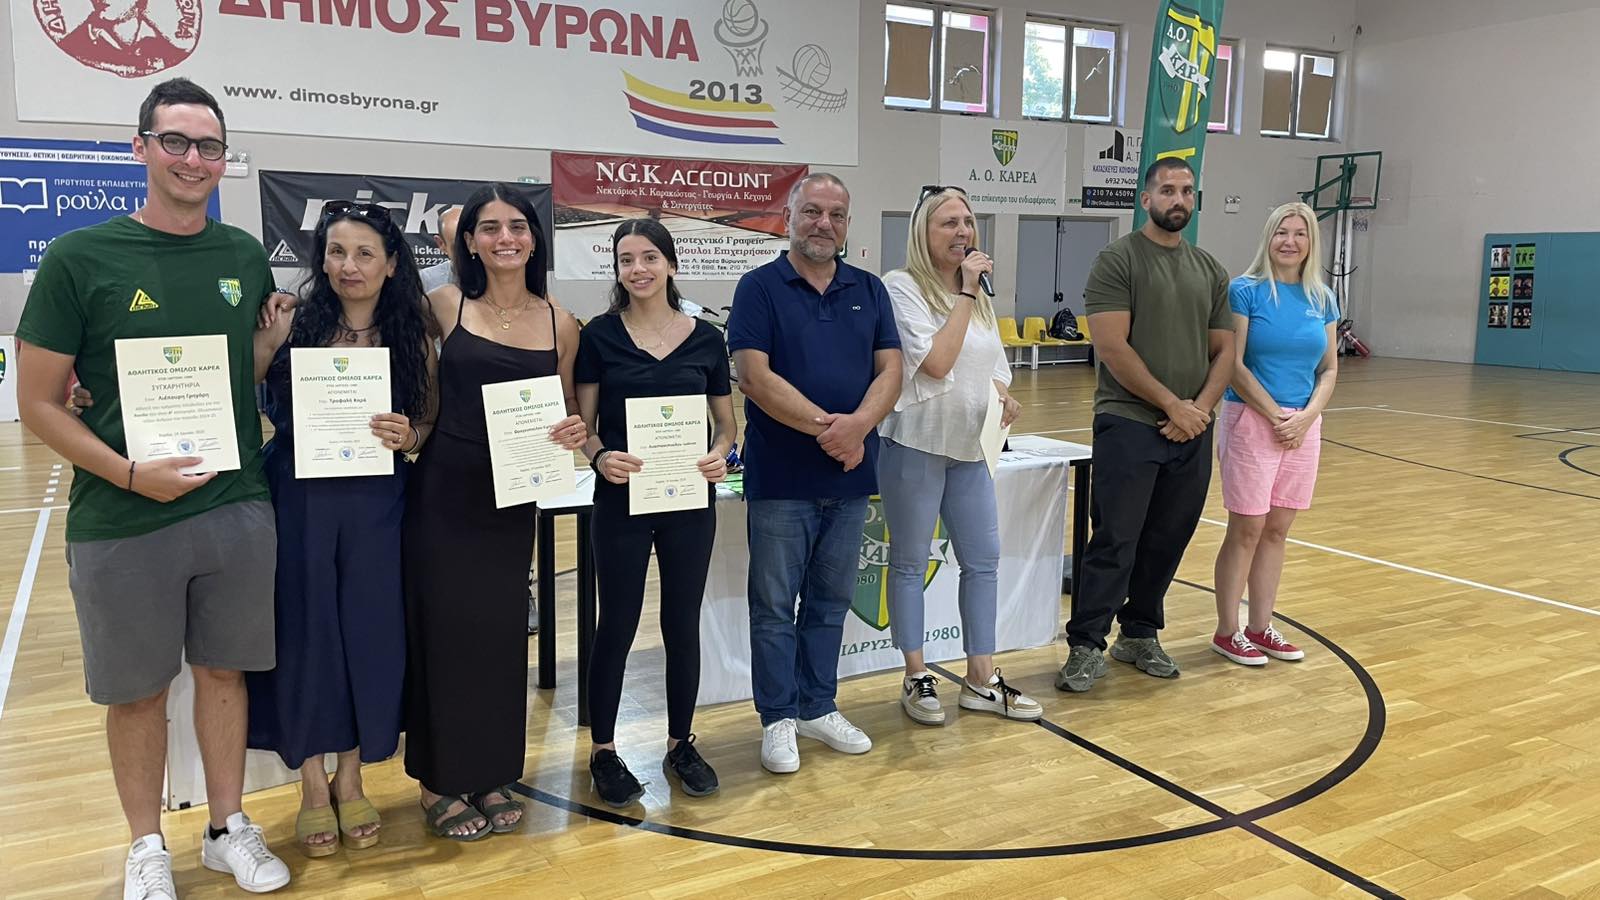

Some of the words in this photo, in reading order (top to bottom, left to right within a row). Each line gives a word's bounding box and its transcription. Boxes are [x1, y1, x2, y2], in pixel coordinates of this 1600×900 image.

[474, 0, 700, 62] ΒΥΡΩΝΑ
[1169, 52, 1200, 81] ΚΑΡ
[688, 79, 763, 105] 2013
[289, 88, 440, 115] dimosbyrona.gr
[999, 170, 1037, 183] ΚΑΡΕΑ
[54, 179, 95, 187] ΠΡΟΤΥΠΟΣ
[97, 179, 147, 188] ΕΚΠΑΙΔΕΥΤΙΚ
[596, 185, 637, 196] Νεκτάριος
[670, 201, 714, 211] Συνεργάτες
[726, 236, 765, 246] Γραφείο
[127, 368, 169, 376] ΑΘΛΗΤΙΚΟΣ
[841, 638, 897, 657] ΙΔΡΥΣ
[924, 626, 961, 643] 1980
